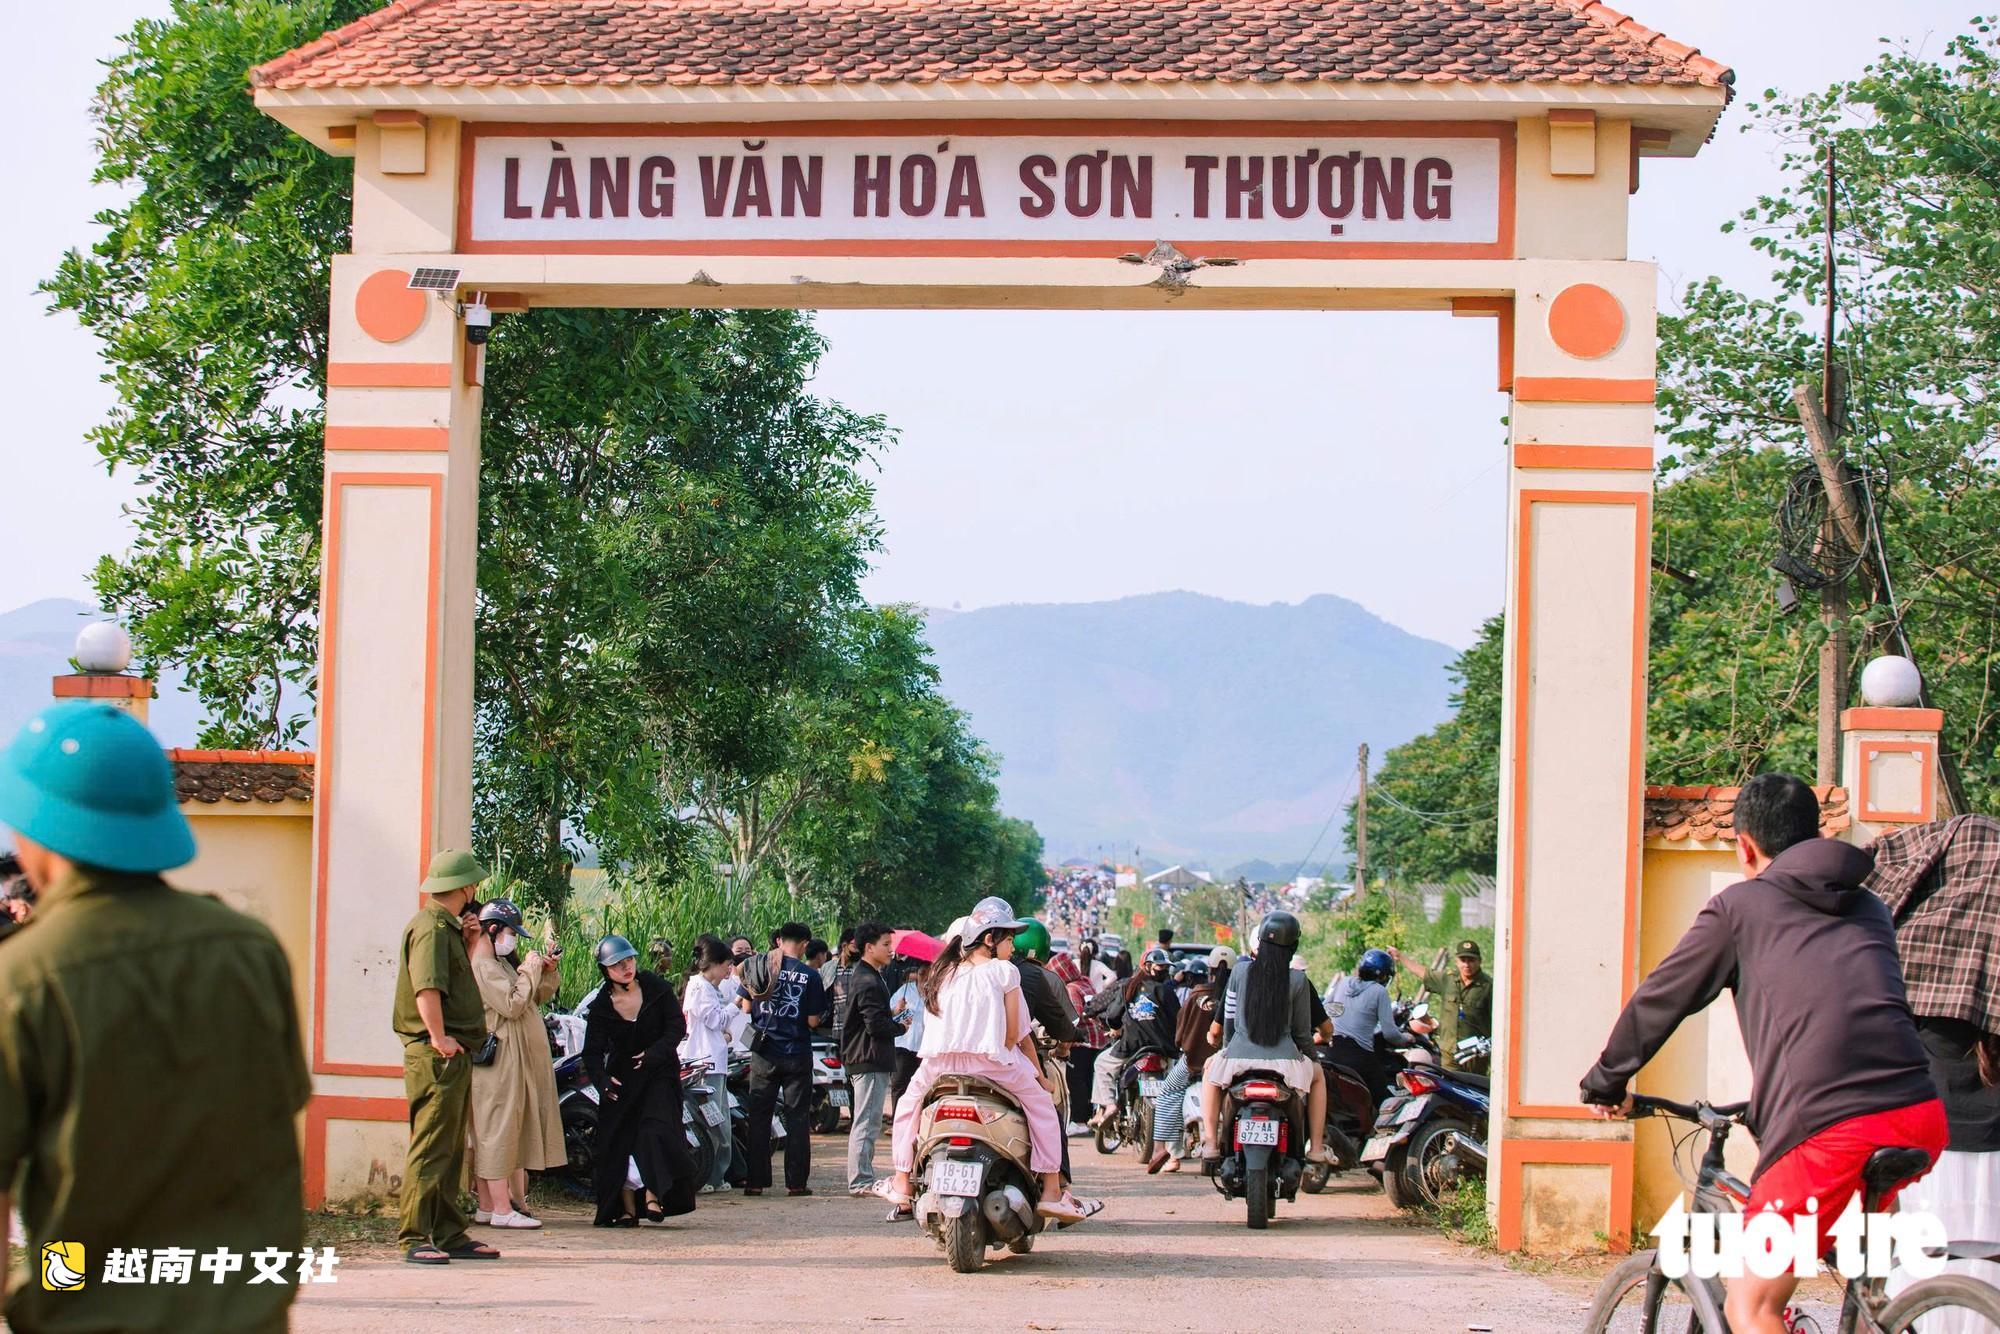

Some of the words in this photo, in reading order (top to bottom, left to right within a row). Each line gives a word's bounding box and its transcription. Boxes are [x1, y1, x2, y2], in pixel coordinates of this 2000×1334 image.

[503, 139, 676, 220] LÀNG
[697, 139, 824, 219] VĂN
[1018, 149, 1153, 219] SƠN
[1184, 147, 1454, 235] THƯỢNG
[778, 969, 810, 984] EWE
[1245, 1121, 1272, 1132] 37-AA
[1241, 1132, 1275, 1143] 972.35
[943, 1163, 975, 1179] 18-G1
[936, 1177, 978, 1193] 154.23
